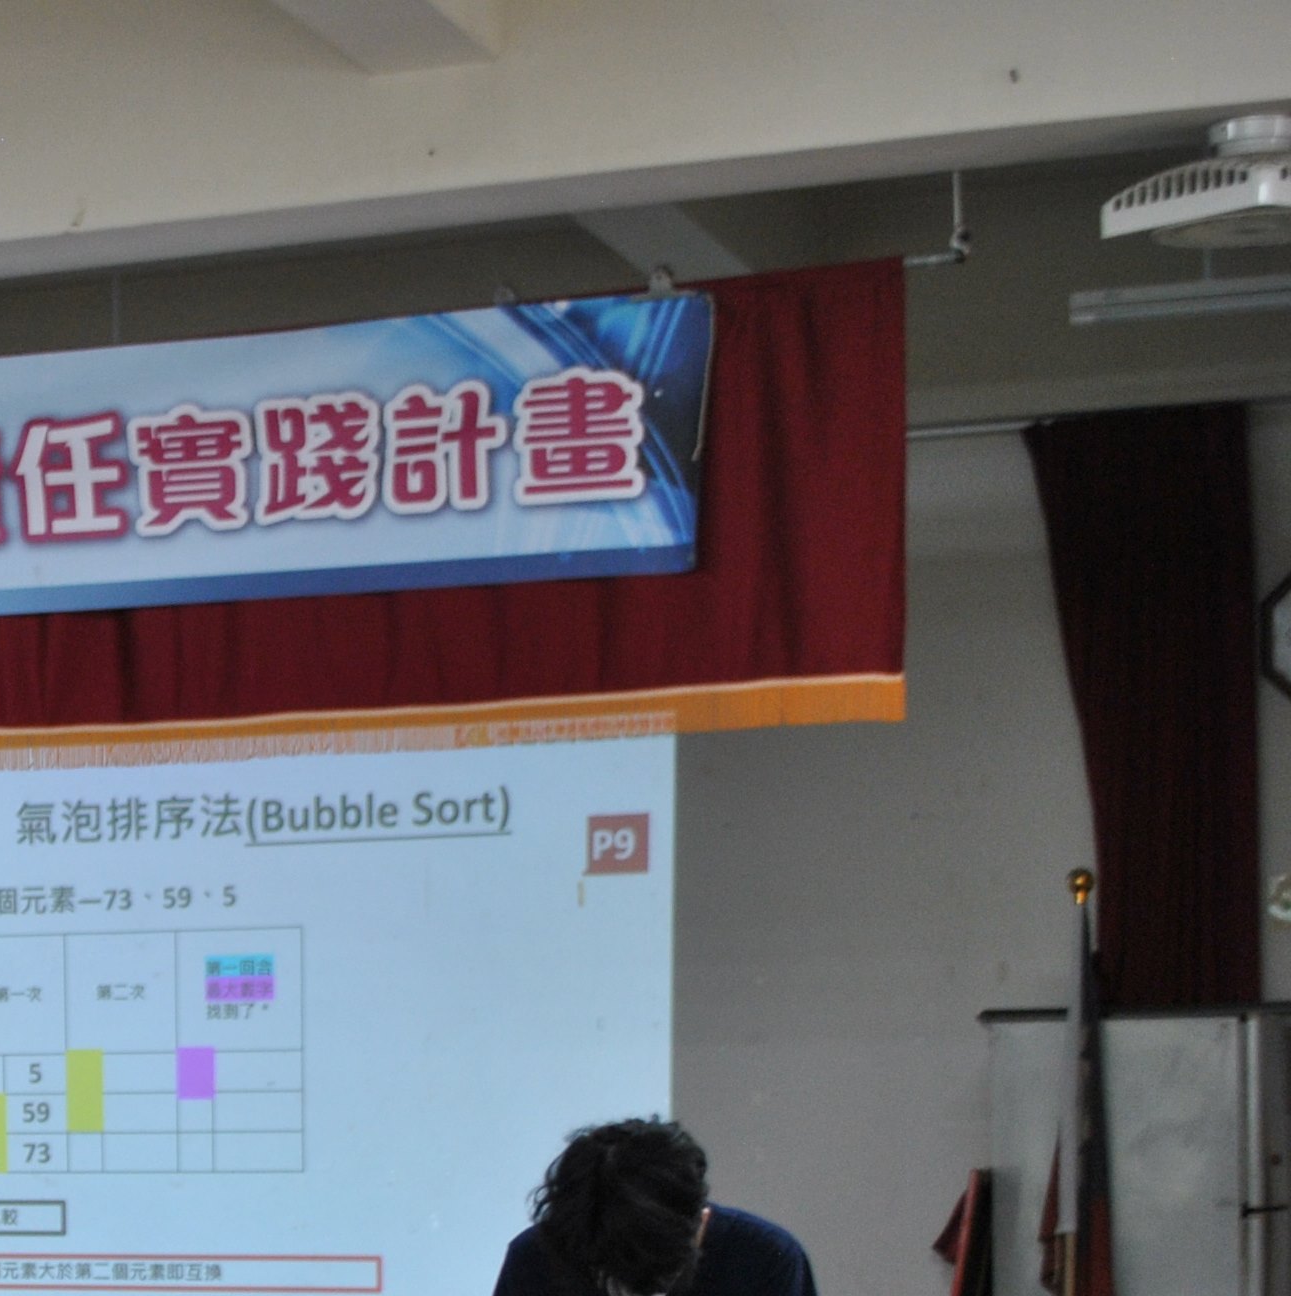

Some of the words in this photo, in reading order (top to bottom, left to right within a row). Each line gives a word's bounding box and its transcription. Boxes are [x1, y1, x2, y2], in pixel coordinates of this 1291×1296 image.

[412, 785, 509, 832] Sort)
[592, 829, 636, 861] P9
[206, 959, 273, 976] 第一回合
[96, 984, 146, 1000] 第二次
[29, 1063, 42, 1084] 5
[22, 1103, 50, 1123] 59
[23, 1143, 51, 1163] 73
